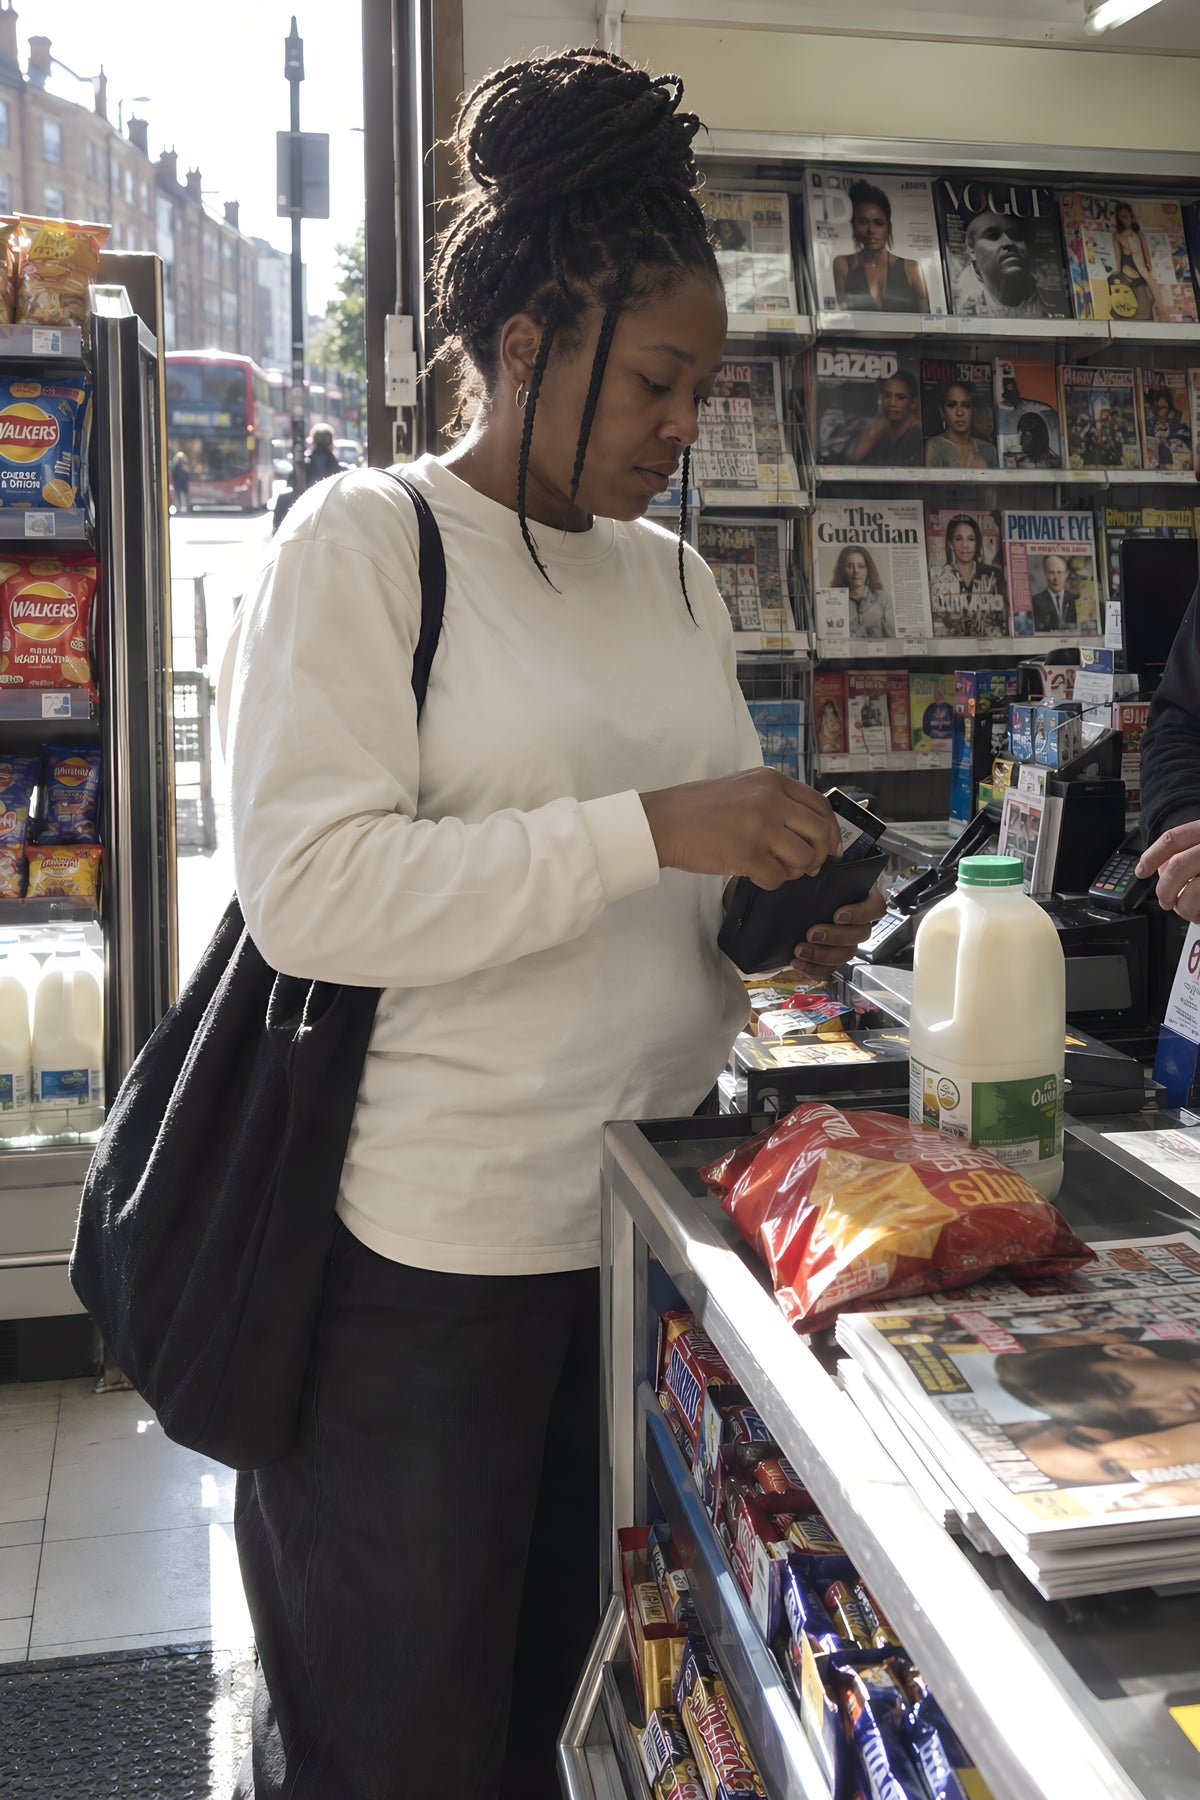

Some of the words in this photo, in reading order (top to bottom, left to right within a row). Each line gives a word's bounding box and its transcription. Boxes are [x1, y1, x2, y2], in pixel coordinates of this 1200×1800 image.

[844, 507, 884, 527] The
[1007, 515, 1065, 540] PRIVATE
[1068, 516, 1092, 540] EYE
[818, 522, 919, 544] Guardian
[13, 601, 77, 618] WALKERS
